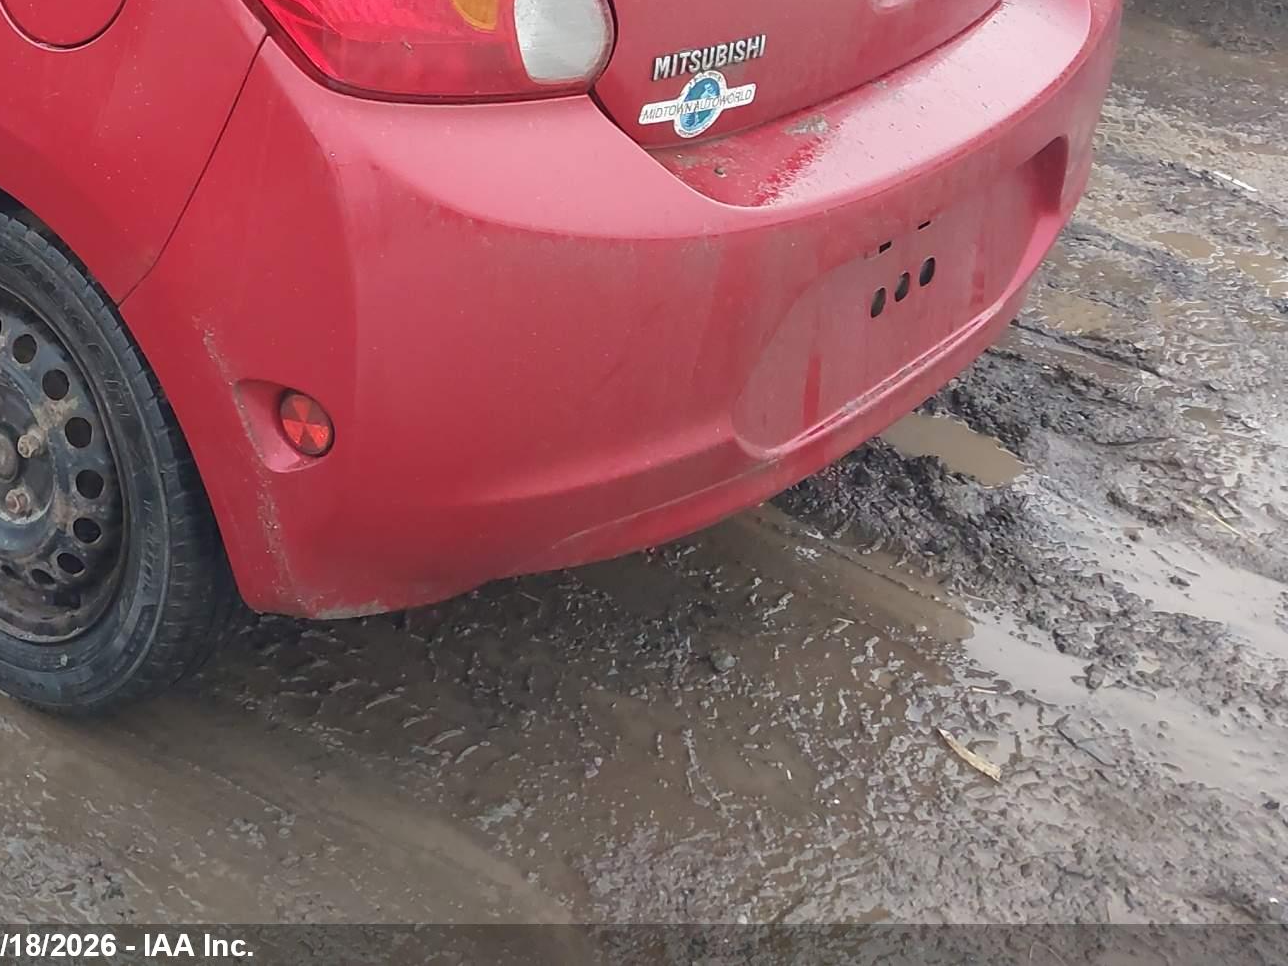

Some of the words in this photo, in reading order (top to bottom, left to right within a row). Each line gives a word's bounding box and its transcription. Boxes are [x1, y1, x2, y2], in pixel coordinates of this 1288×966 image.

[652, 34, 767, 81] MITSUBISHI
[642, 101, 695, 122] MIDTOWN
[693, 89, 753, 112] AUTOWORLD
